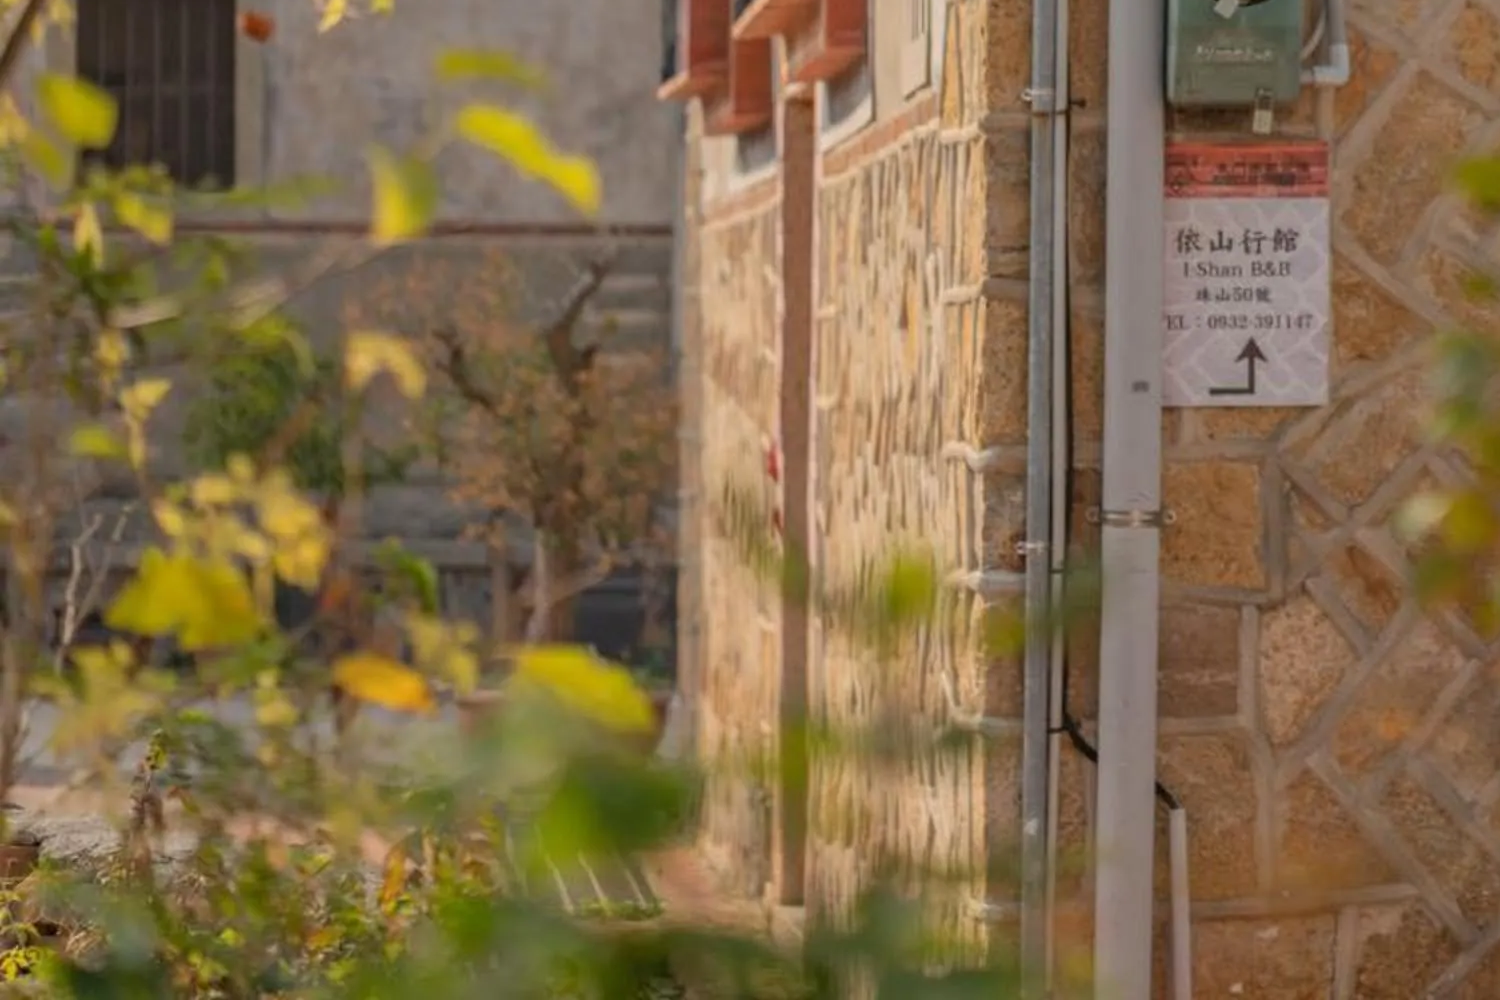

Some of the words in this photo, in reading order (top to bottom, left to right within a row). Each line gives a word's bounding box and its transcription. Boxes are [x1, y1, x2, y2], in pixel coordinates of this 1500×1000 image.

[1175, 227, 1299, 255] 依山行館
[1196, 261, 1243, 277] Shan
[1251, 261, 1291, 277] B&B
